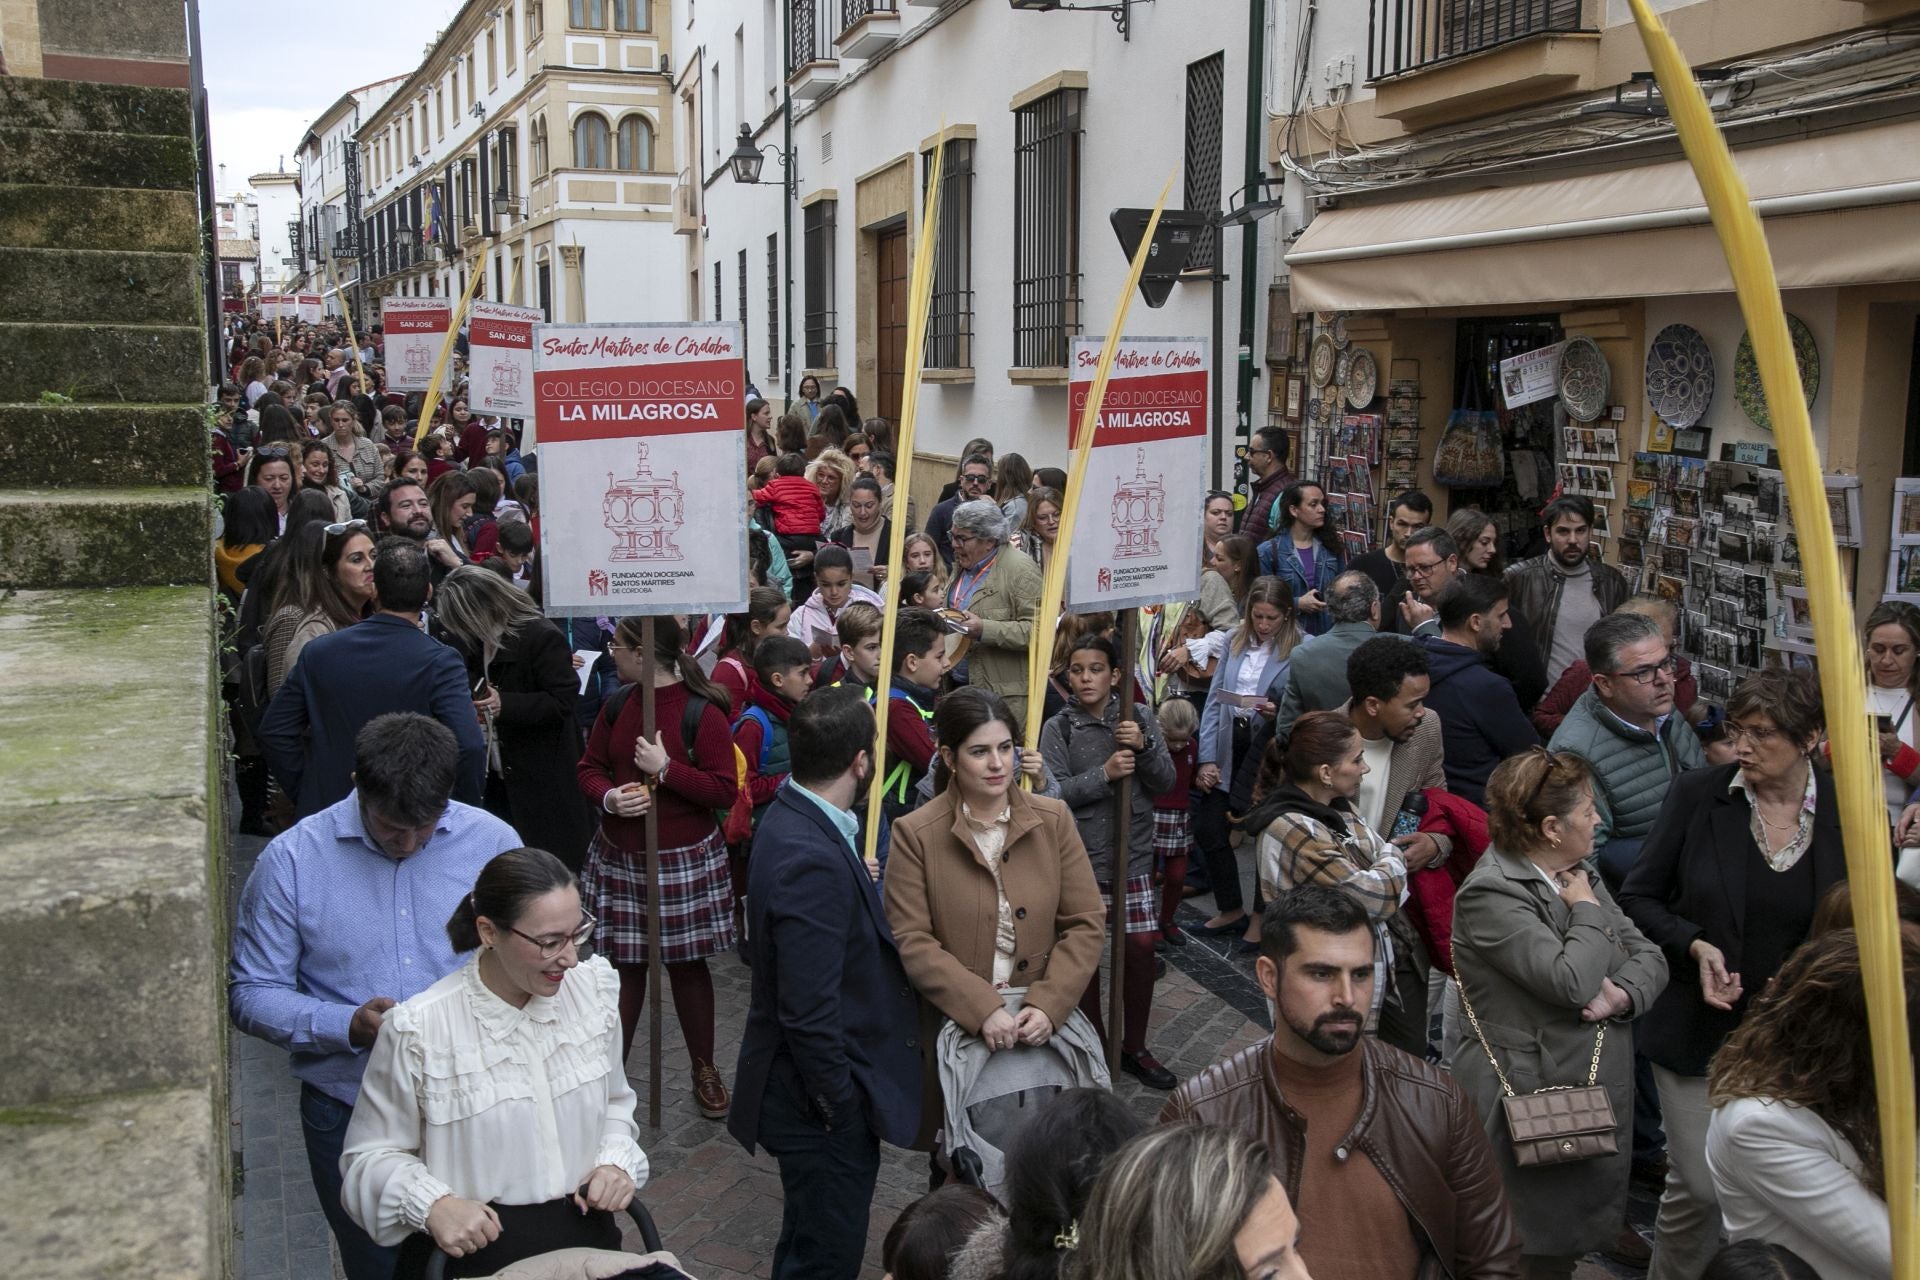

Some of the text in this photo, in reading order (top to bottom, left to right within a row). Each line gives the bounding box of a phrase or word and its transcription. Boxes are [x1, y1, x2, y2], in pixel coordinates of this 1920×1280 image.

[347, 144, 358, 245] EL CONQUISTADOR
[290, 224, 299, 258] HOTEL
[489, 331, 505, 340] SAN
[543, 336, 732, 358] Santos Mártires de Córdoba
[1077, 350, 1103, 368] Sant
[1152, 350, 1163, 365] de
[1165, 350, 1201, 368] Córdoba
[542, 379, 735, 397] COLEGIO DIOCESANO
[1075, 390, 1202, 406] CEGIO DIOCESANO
[560, 403, 718, 421] LA MILAGROSA
[1109, 411, 1191, 428] MILAGROSA
[612, 571, 652, 579] FUNDACIÓN
